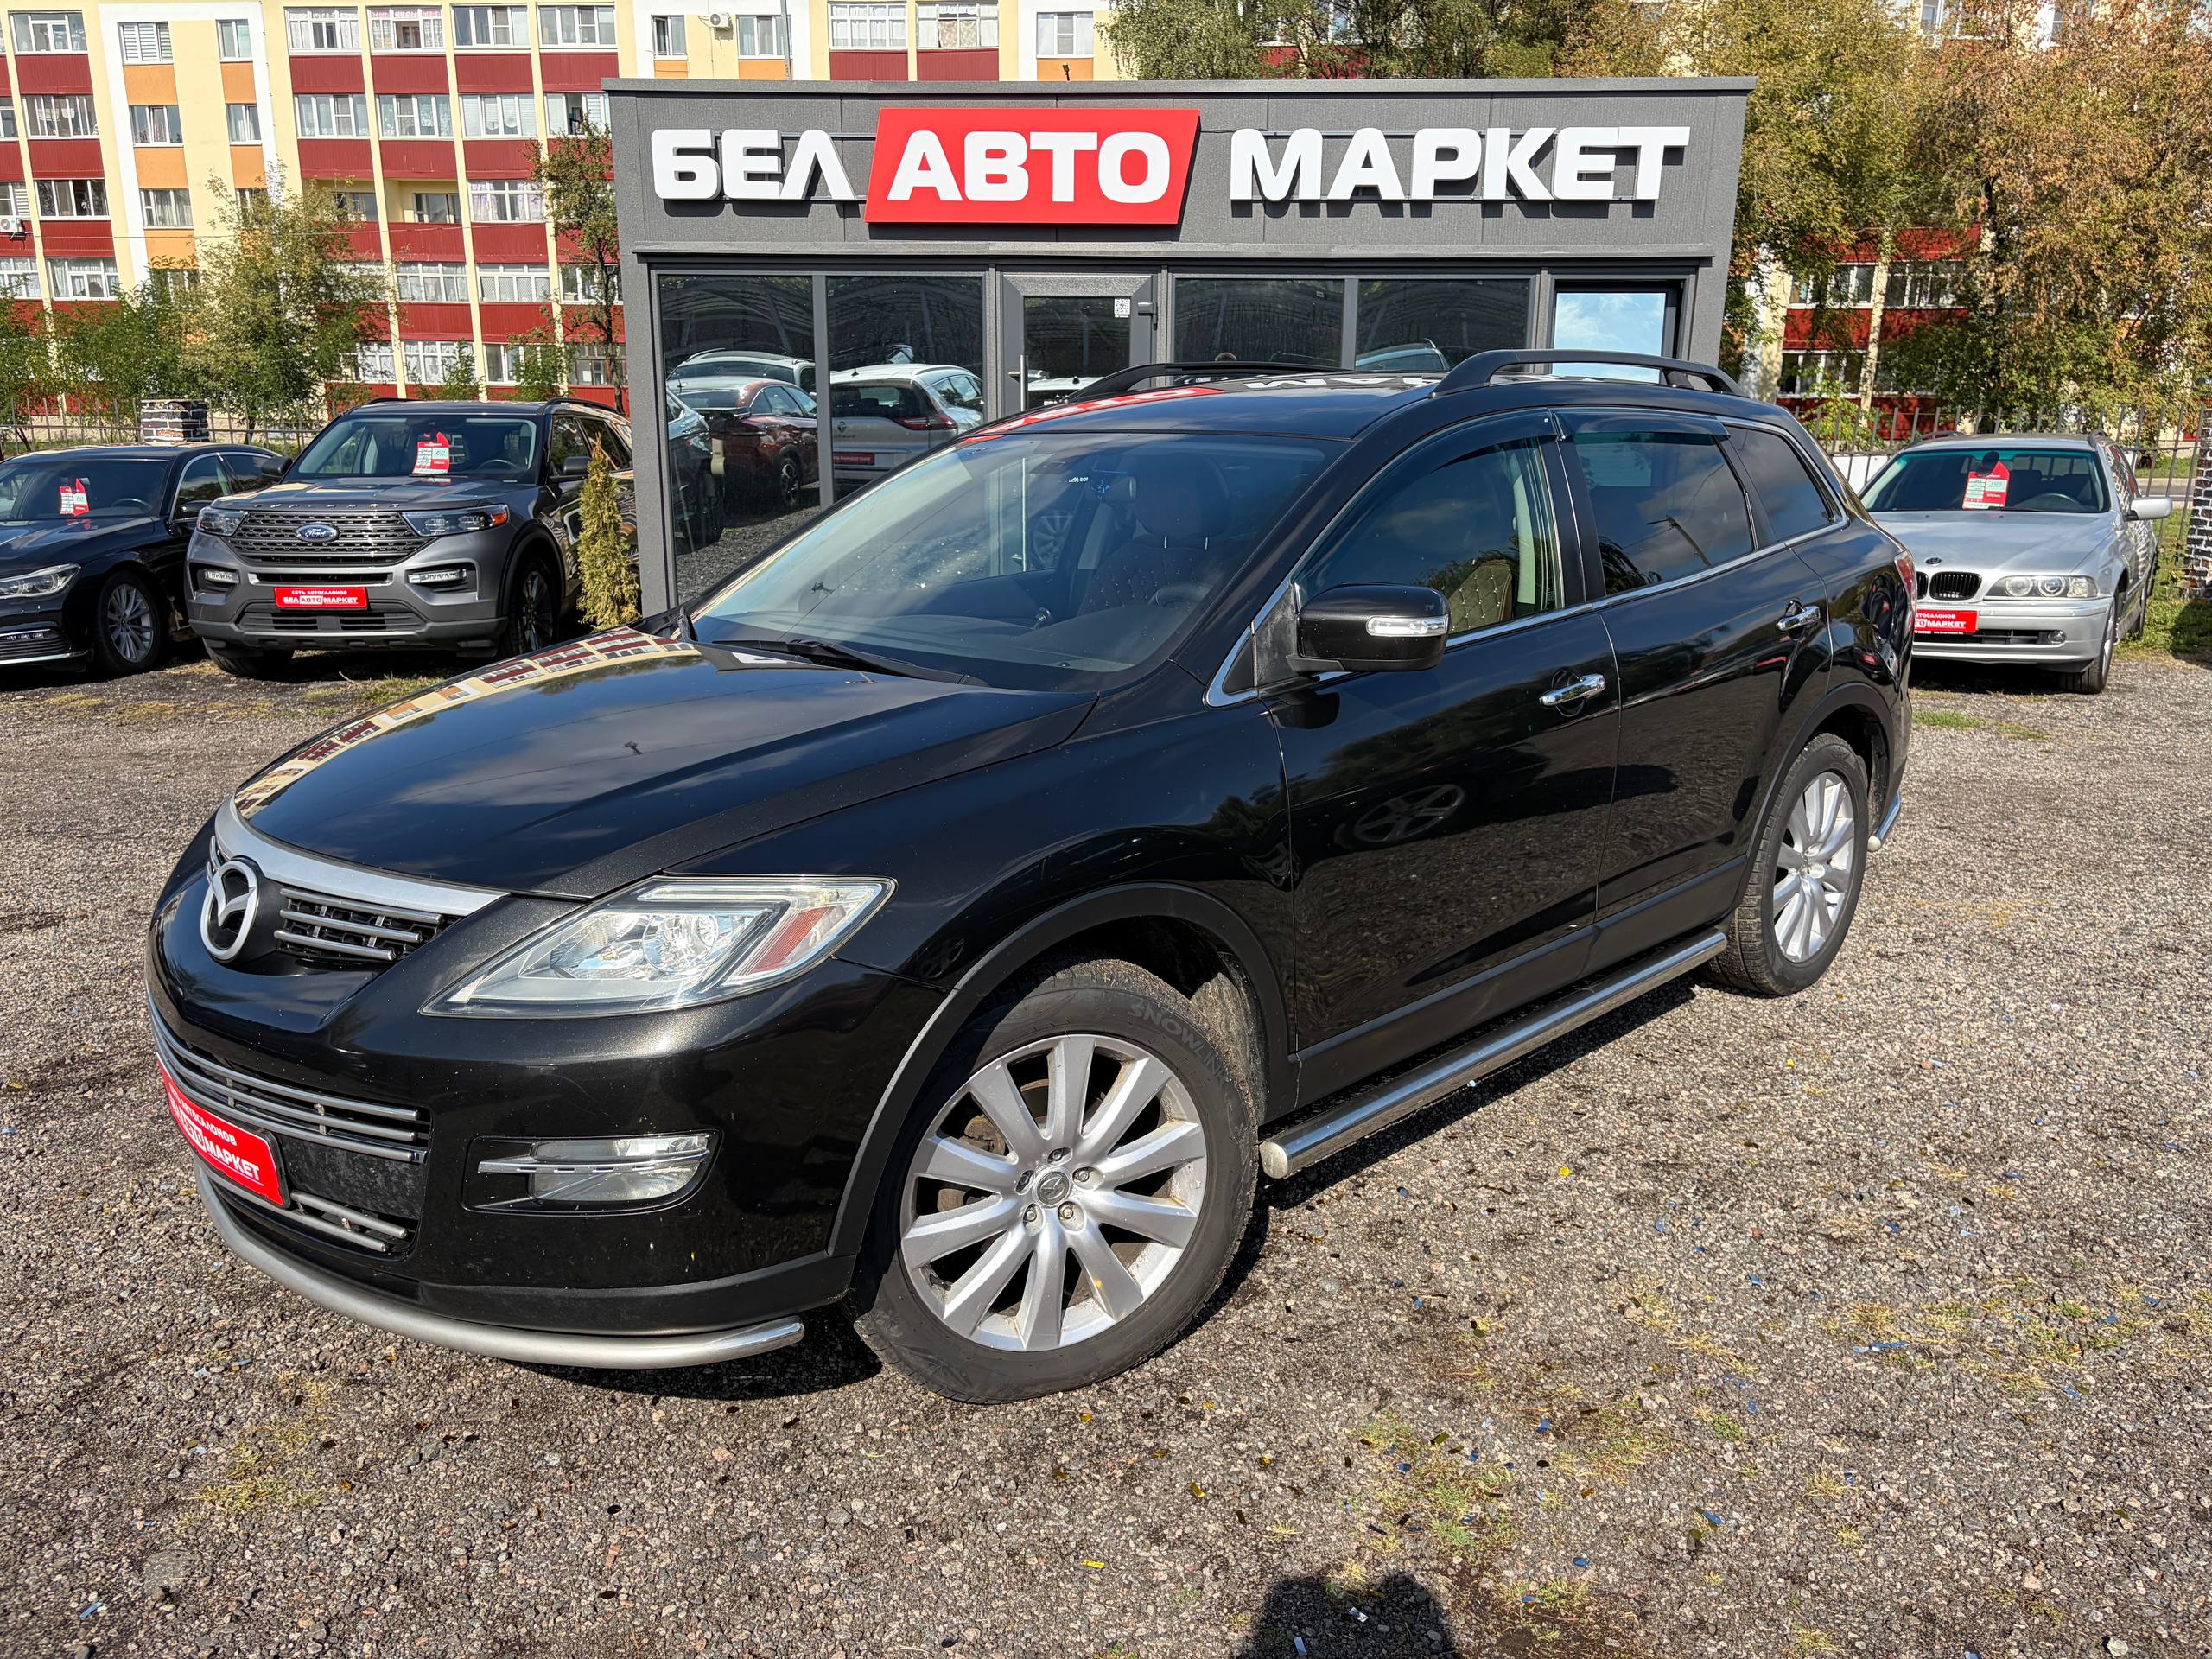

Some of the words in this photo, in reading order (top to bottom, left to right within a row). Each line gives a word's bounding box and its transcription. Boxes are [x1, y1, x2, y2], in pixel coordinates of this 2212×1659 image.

[652, 129, 856, 200] БЕЛ
[887, 130, 1171, 204] АВТО
[1230, 126, 1691, 201] МАРКЕТ
[303, 526, 327, 538] Ford
[1927, 620, 1967, 629] МАРКЕТ
[203, 1136, 260, 1181] МАРКЕТ
